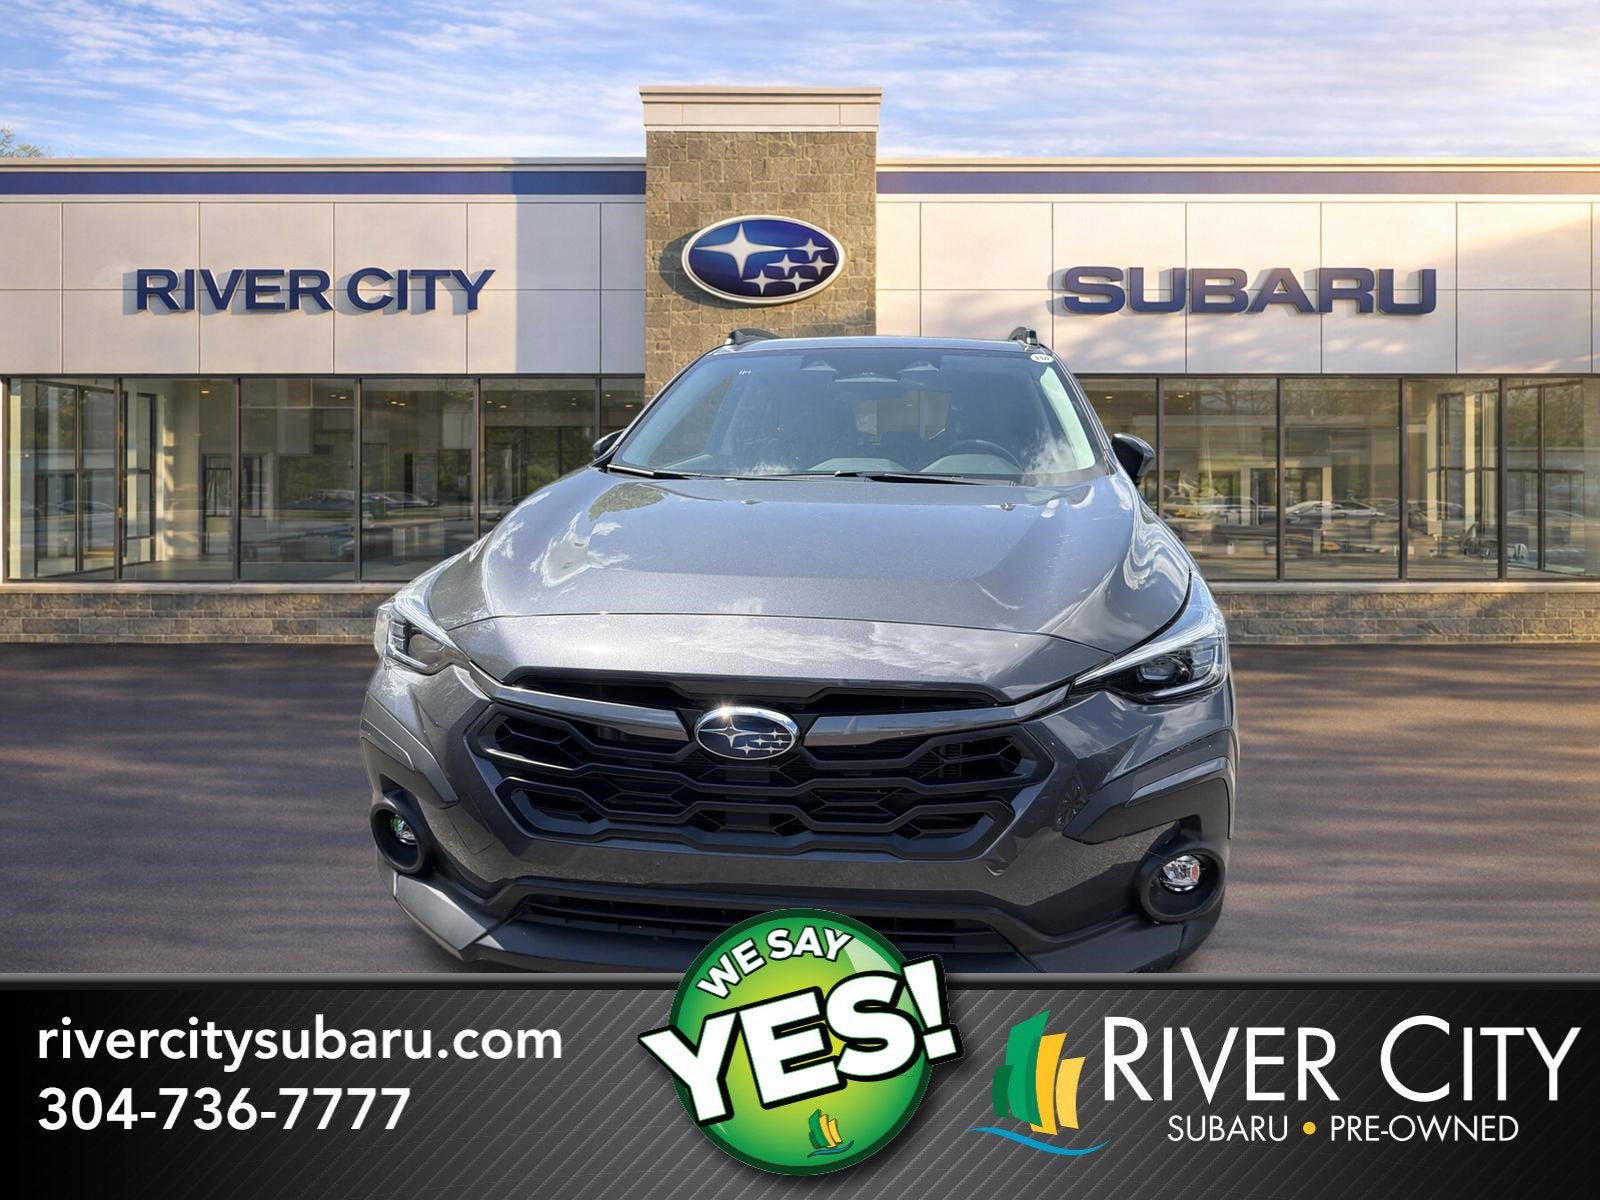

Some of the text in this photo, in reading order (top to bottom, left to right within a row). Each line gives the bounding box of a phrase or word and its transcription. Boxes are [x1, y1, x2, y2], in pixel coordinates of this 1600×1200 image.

[136, 267, 496, 311] RIVER CITY
[1063, 266, 1437, 315] SUBARU
